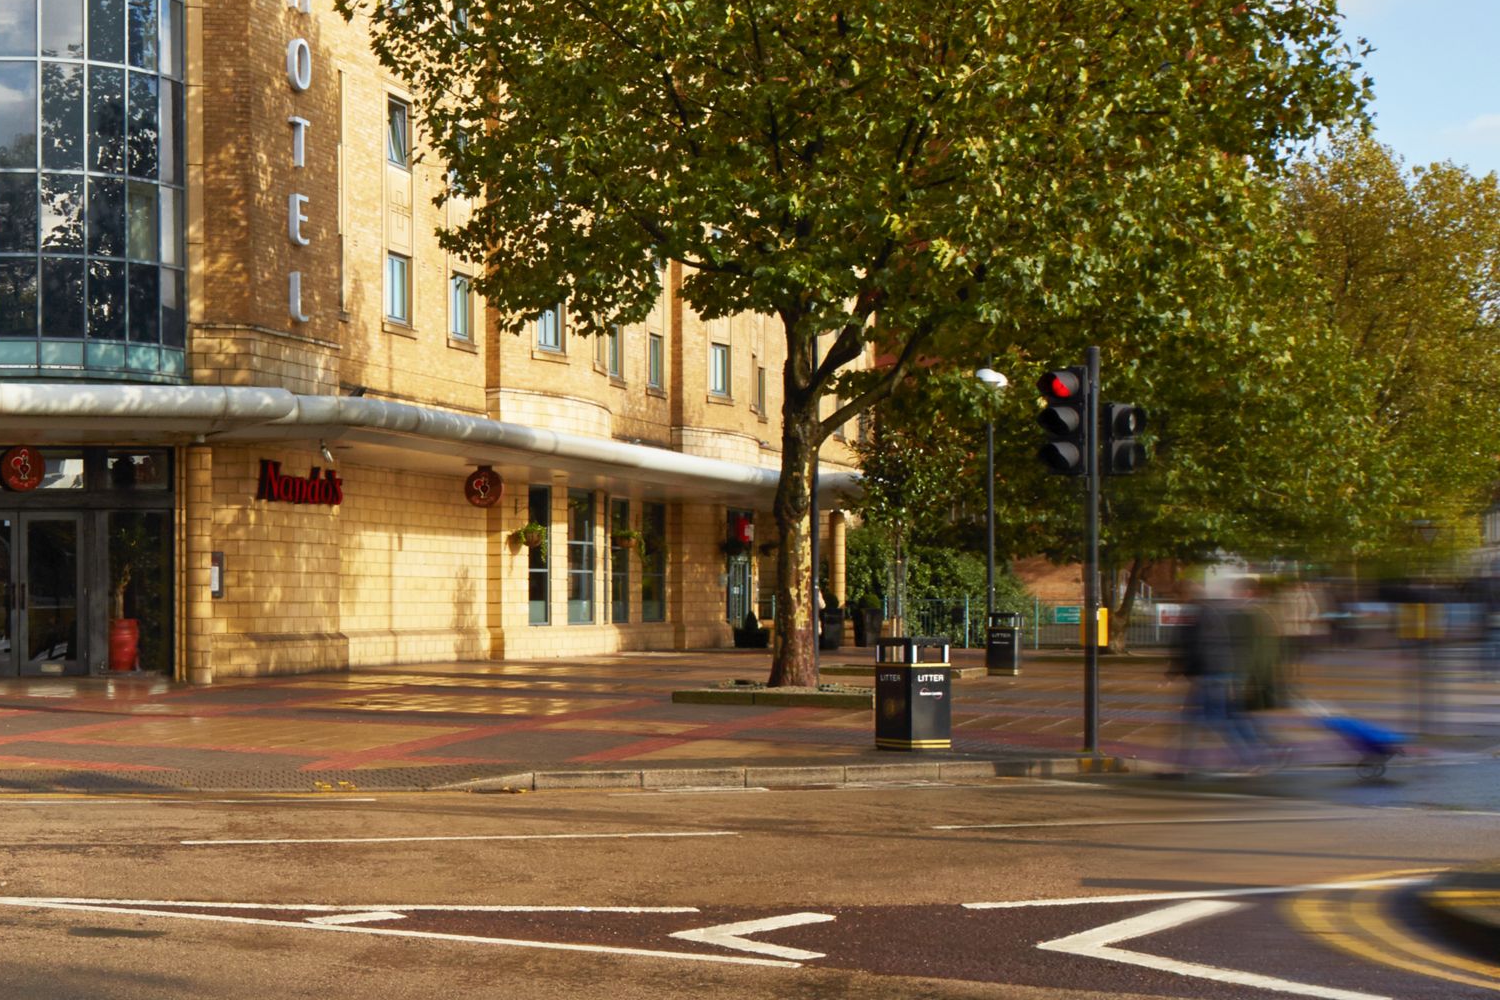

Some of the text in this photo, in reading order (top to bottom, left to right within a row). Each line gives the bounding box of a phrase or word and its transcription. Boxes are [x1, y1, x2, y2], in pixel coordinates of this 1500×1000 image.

[256, 459, 344, 505] Nando's
[880, 674, 901, 682] LITTER
[917, 674, 944, 682] LITTER
